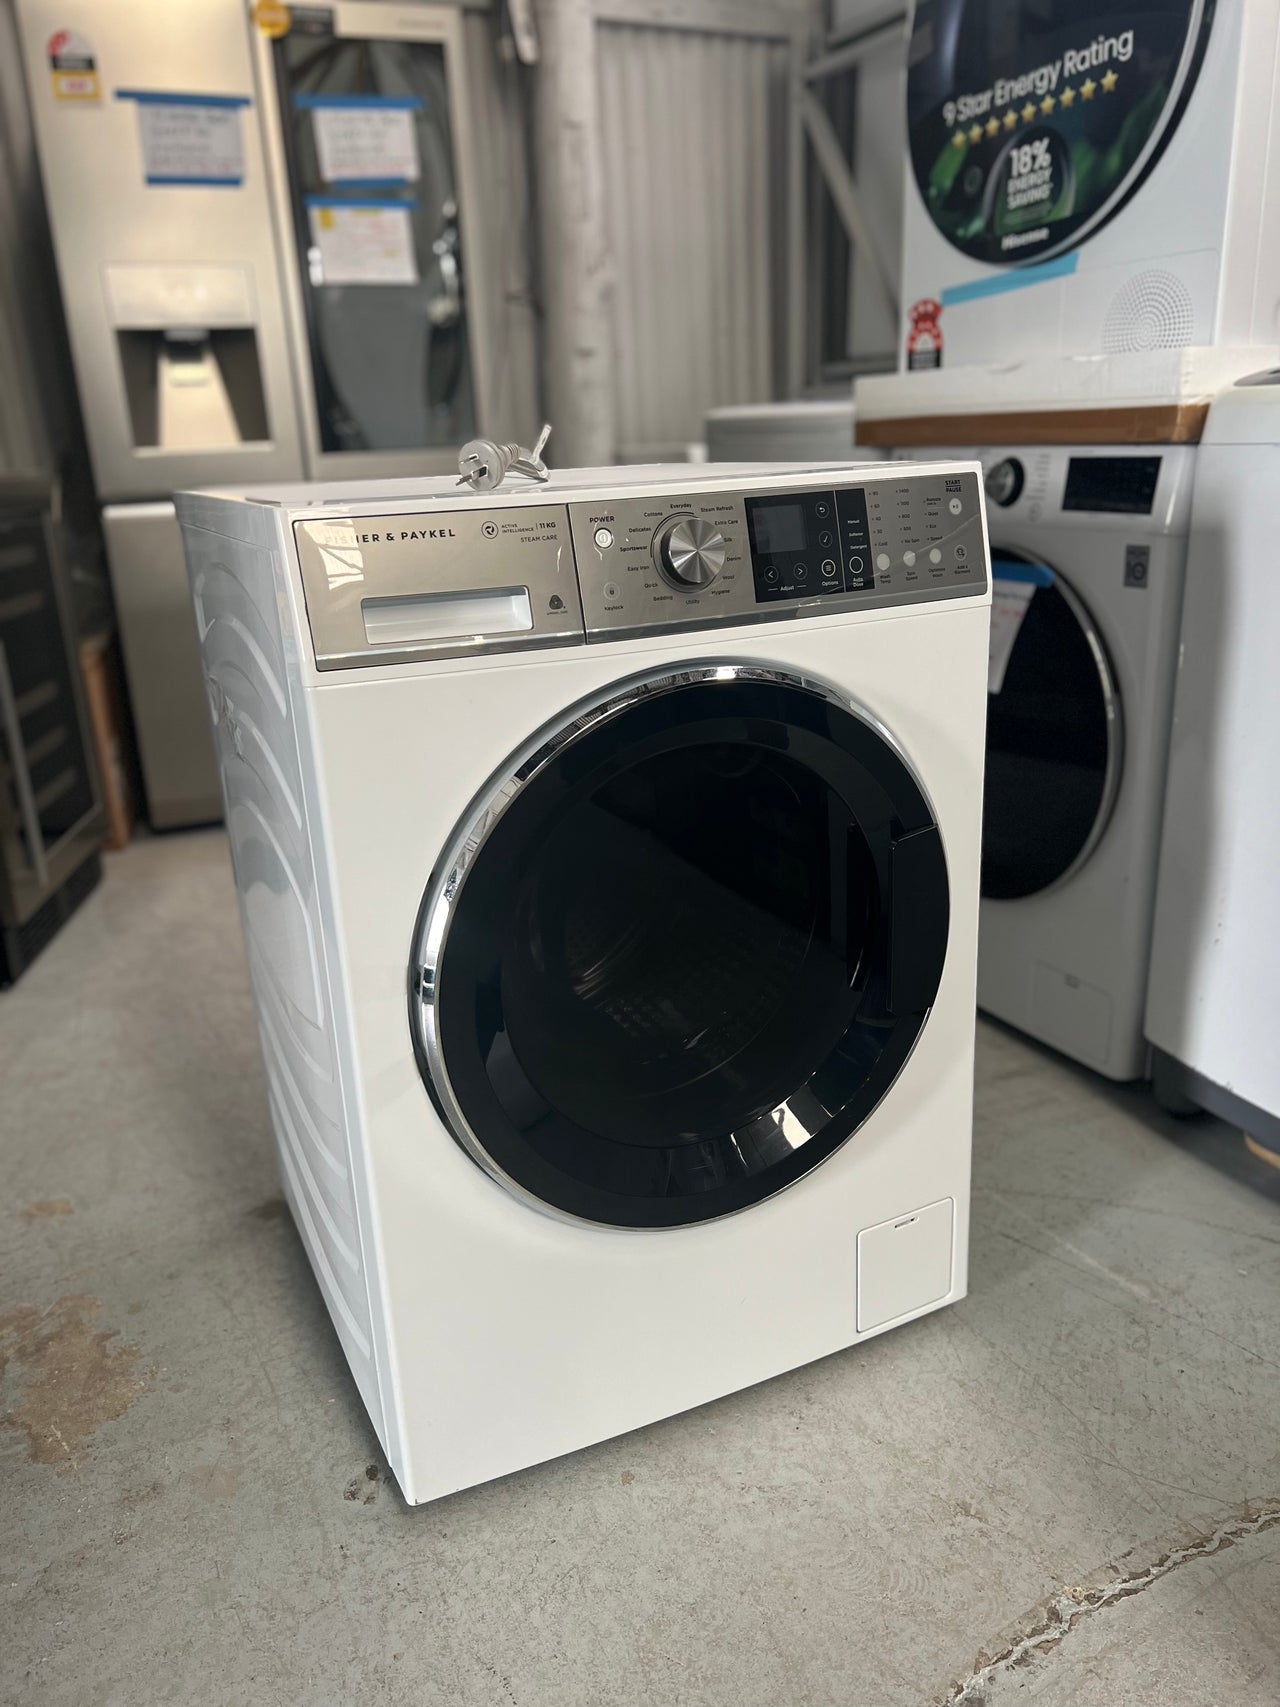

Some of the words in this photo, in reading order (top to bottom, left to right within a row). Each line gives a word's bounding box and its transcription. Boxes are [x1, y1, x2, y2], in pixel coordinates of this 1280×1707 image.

[942, 101, 957, 127] 9
[956, 89, 994, 122] Star
[994, 60, 1062, 107] Energy
[1063, 29, 1134, 78] Rating
[1009, 136, 1052, 178] 18%
[589, 515, 615, 524] POWER
[546, 521, 556, 529] KG
[386, 532, 395, 542] &
[401, 528, 456, 541] PAYKEL
[542, 534, 558, 542] CARE
[619, 545, 648, 553] Sportswear
